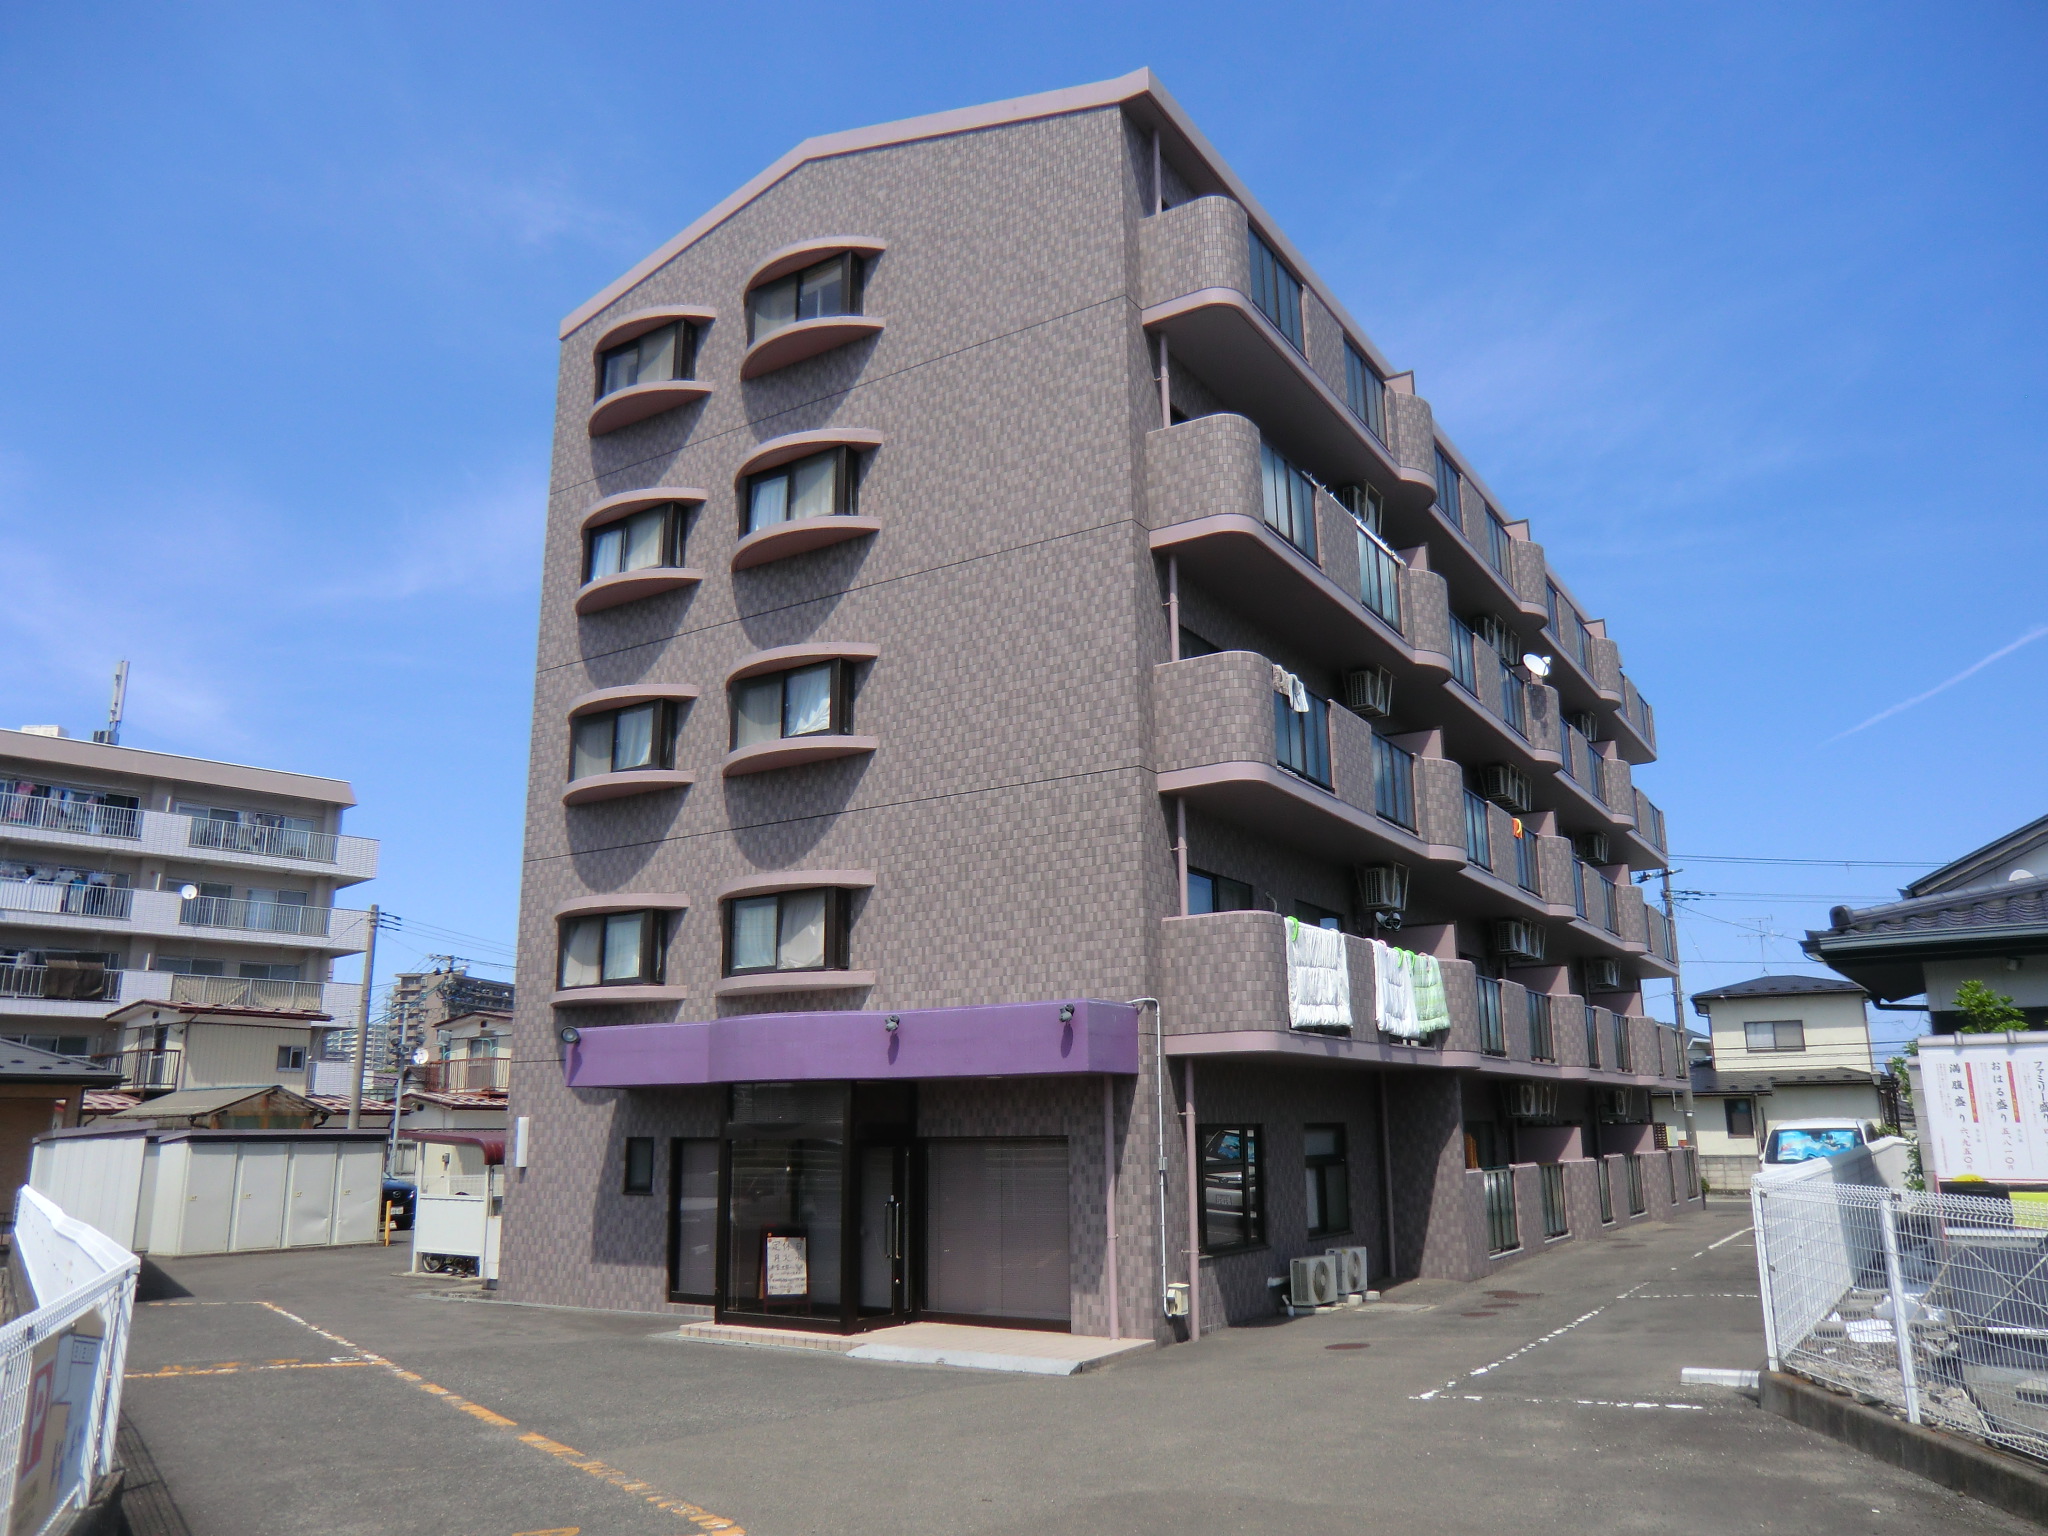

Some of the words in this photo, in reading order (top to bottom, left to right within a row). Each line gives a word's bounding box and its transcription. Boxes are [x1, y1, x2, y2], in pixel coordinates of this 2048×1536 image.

[1949, 1063, 1966, 1122] 満腹盛り
[1992, 1061, 2008, 1122] おはる盛り
[772, 1240, 802, 1251] 定休日
